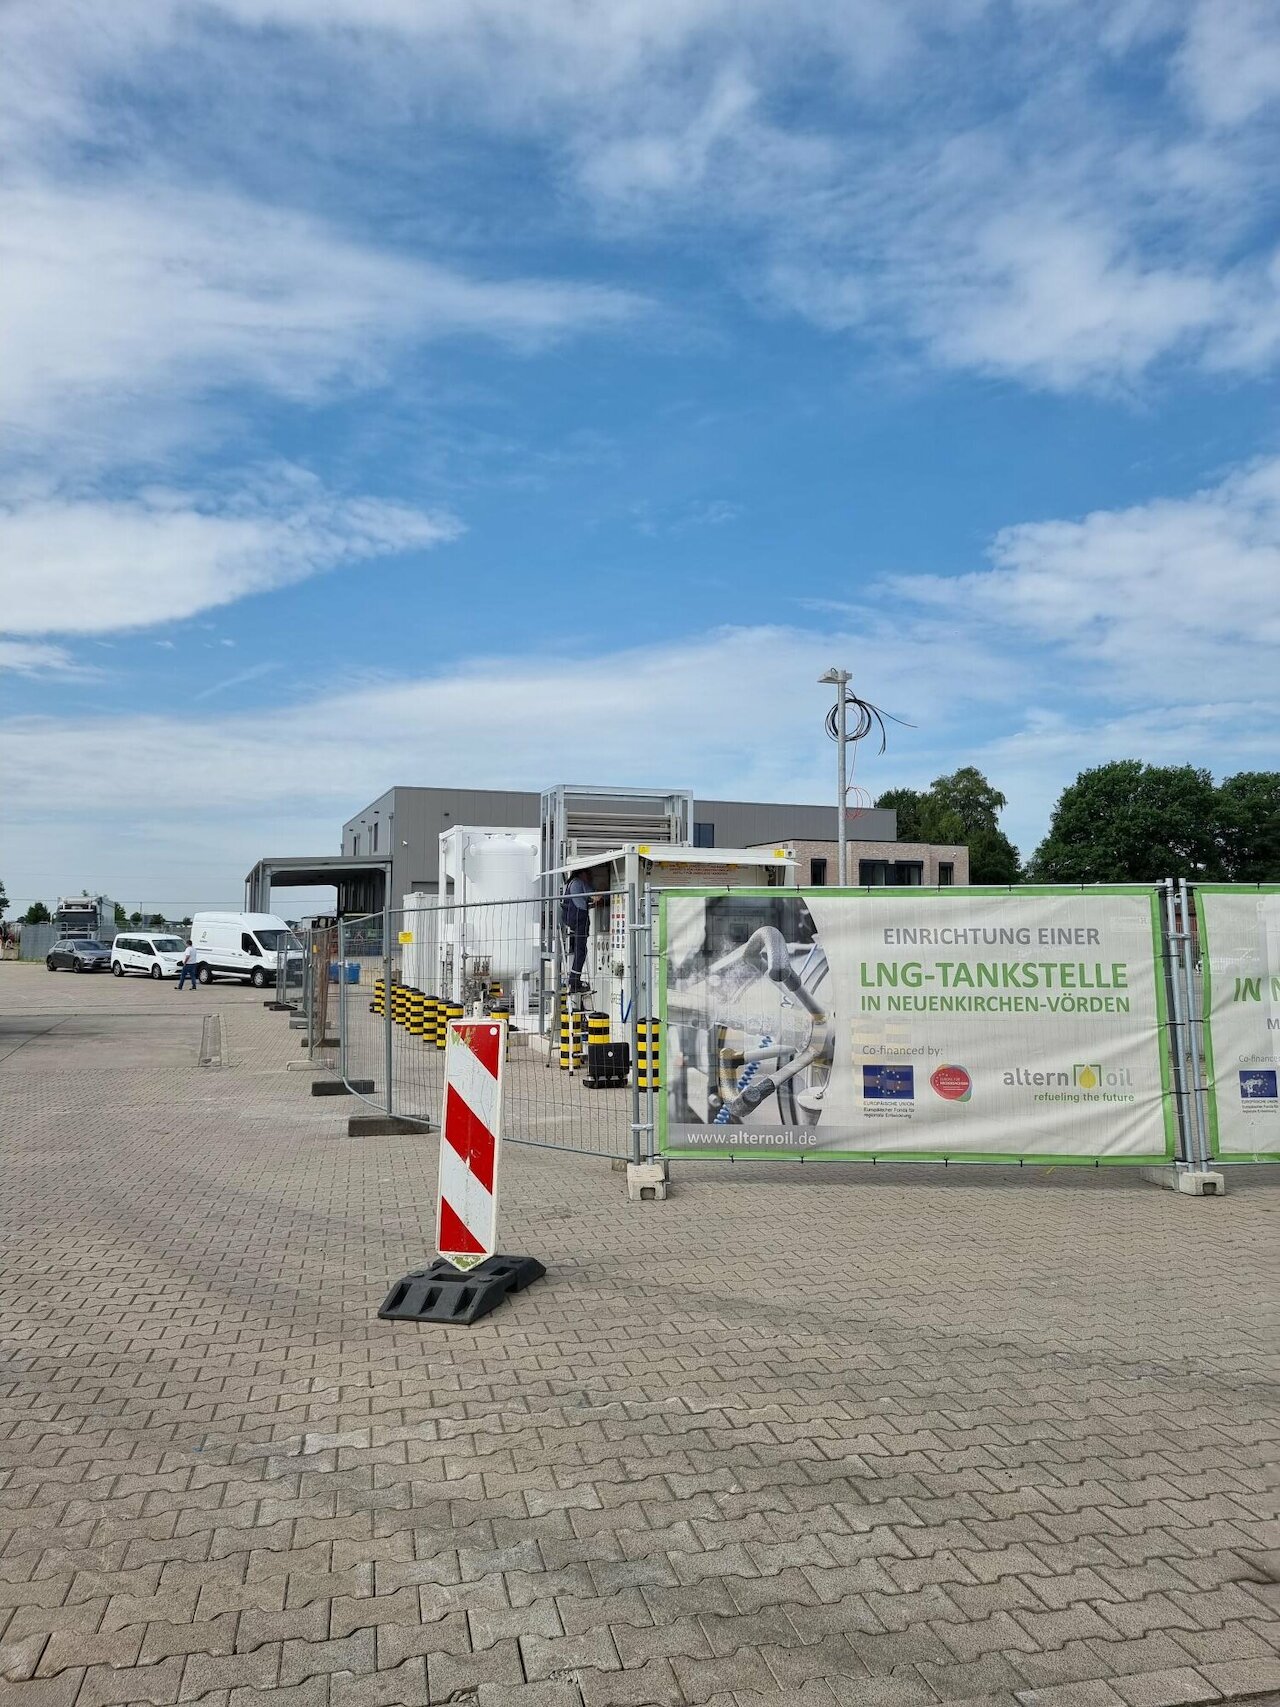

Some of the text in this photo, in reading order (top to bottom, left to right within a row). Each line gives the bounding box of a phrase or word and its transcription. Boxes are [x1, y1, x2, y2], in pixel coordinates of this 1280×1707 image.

[883, 927, 1101, 945] EINRICHTUNG EINER
[860, 962, 1129, 989] LNG-TANKSTELLE
[1233, 977, 1262, 1002] IN
[861, 993, 1130, 1013] IN NEUENKIRCHEN-VÖRDEN
[862, 1045, 944, 1058] Co-financed by:
[1034, 1092, 1135, 1104] refueling the future
[687, 1130, 817, 1146] www.alternoil.de
